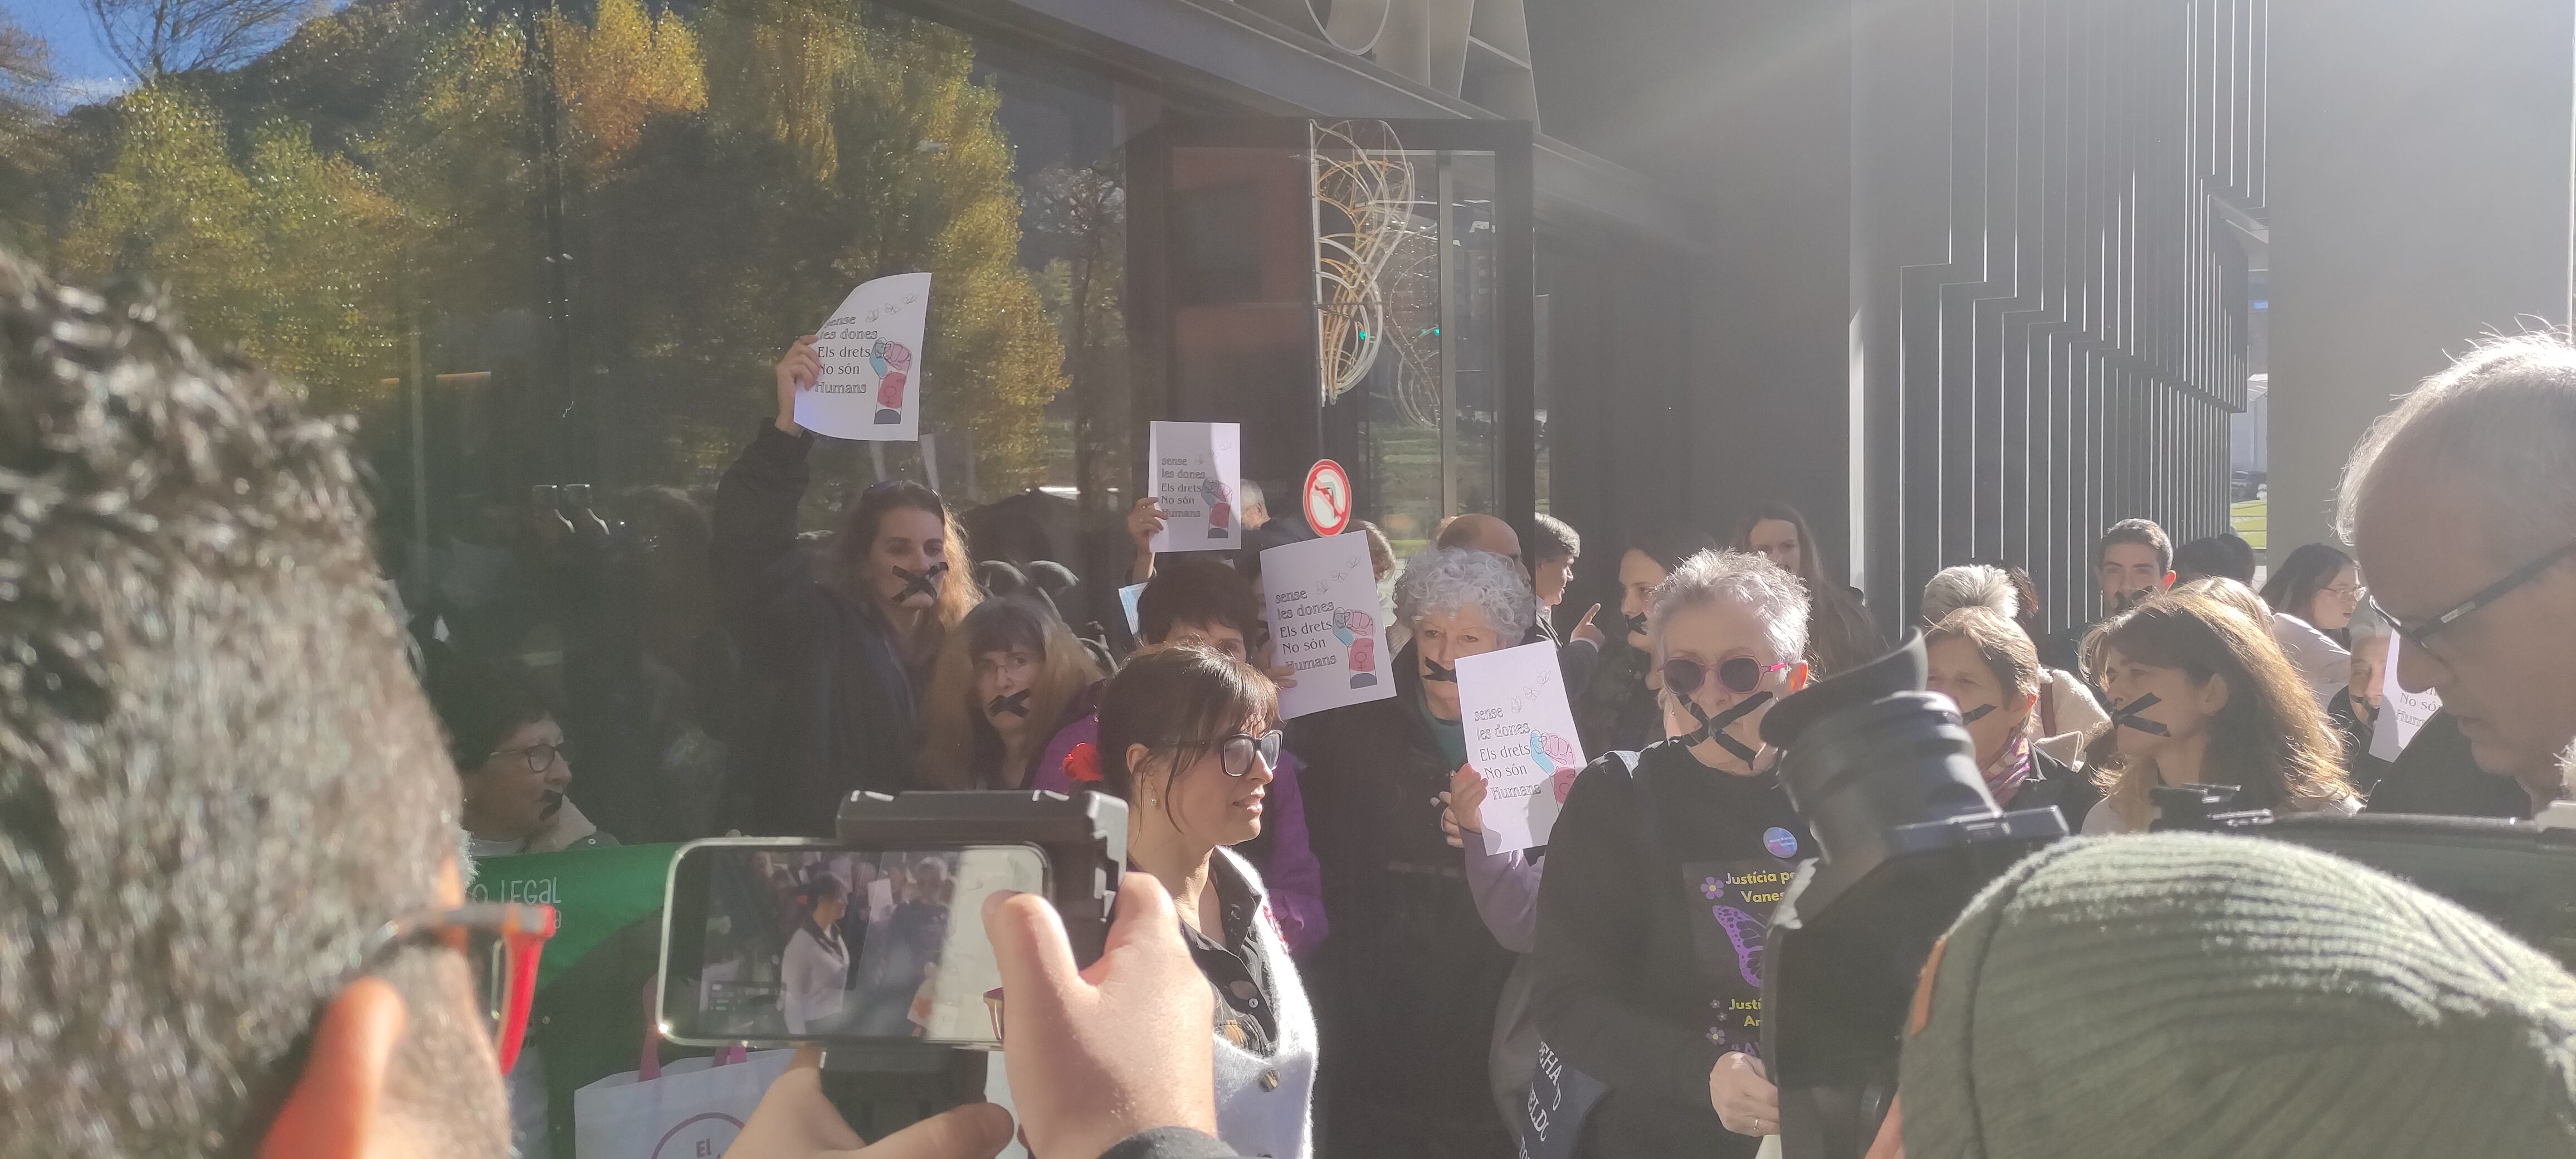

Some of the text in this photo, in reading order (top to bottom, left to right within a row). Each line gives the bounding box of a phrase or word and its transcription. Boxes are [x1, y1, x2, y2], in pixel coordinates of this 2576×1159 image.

[840, 328, 879, 340] dones
[818, 345, 871, 358] Els drets
[838, 363, 860, 374] són
[814, 382, 867, 394] Humans
[1162, 456, 1188, 466] sense
[1162, 469, 1206, 479] les dones
[1162, 483, 1202, 493] Els drets
[1161, 495, 1194, 504] No són
[1275, 590, 1307, 604] sense
[1277, 601, 1334, 620] les dones
[1280, 620, 1333, 638] Els drets
[1282, 639, 1326, 654] No són
[2400, 693, 2442, 712] No só
[1474, 707, 1504, 722] sense
[1477, 722, 1530, 741] les dones
[1480, 742, 1530, 761] Els drets
[1484, 763, 1528, 780] No són
[1490, 783, 1541, 800] Humans
[1726, 870, 1777, 885] Justícia
